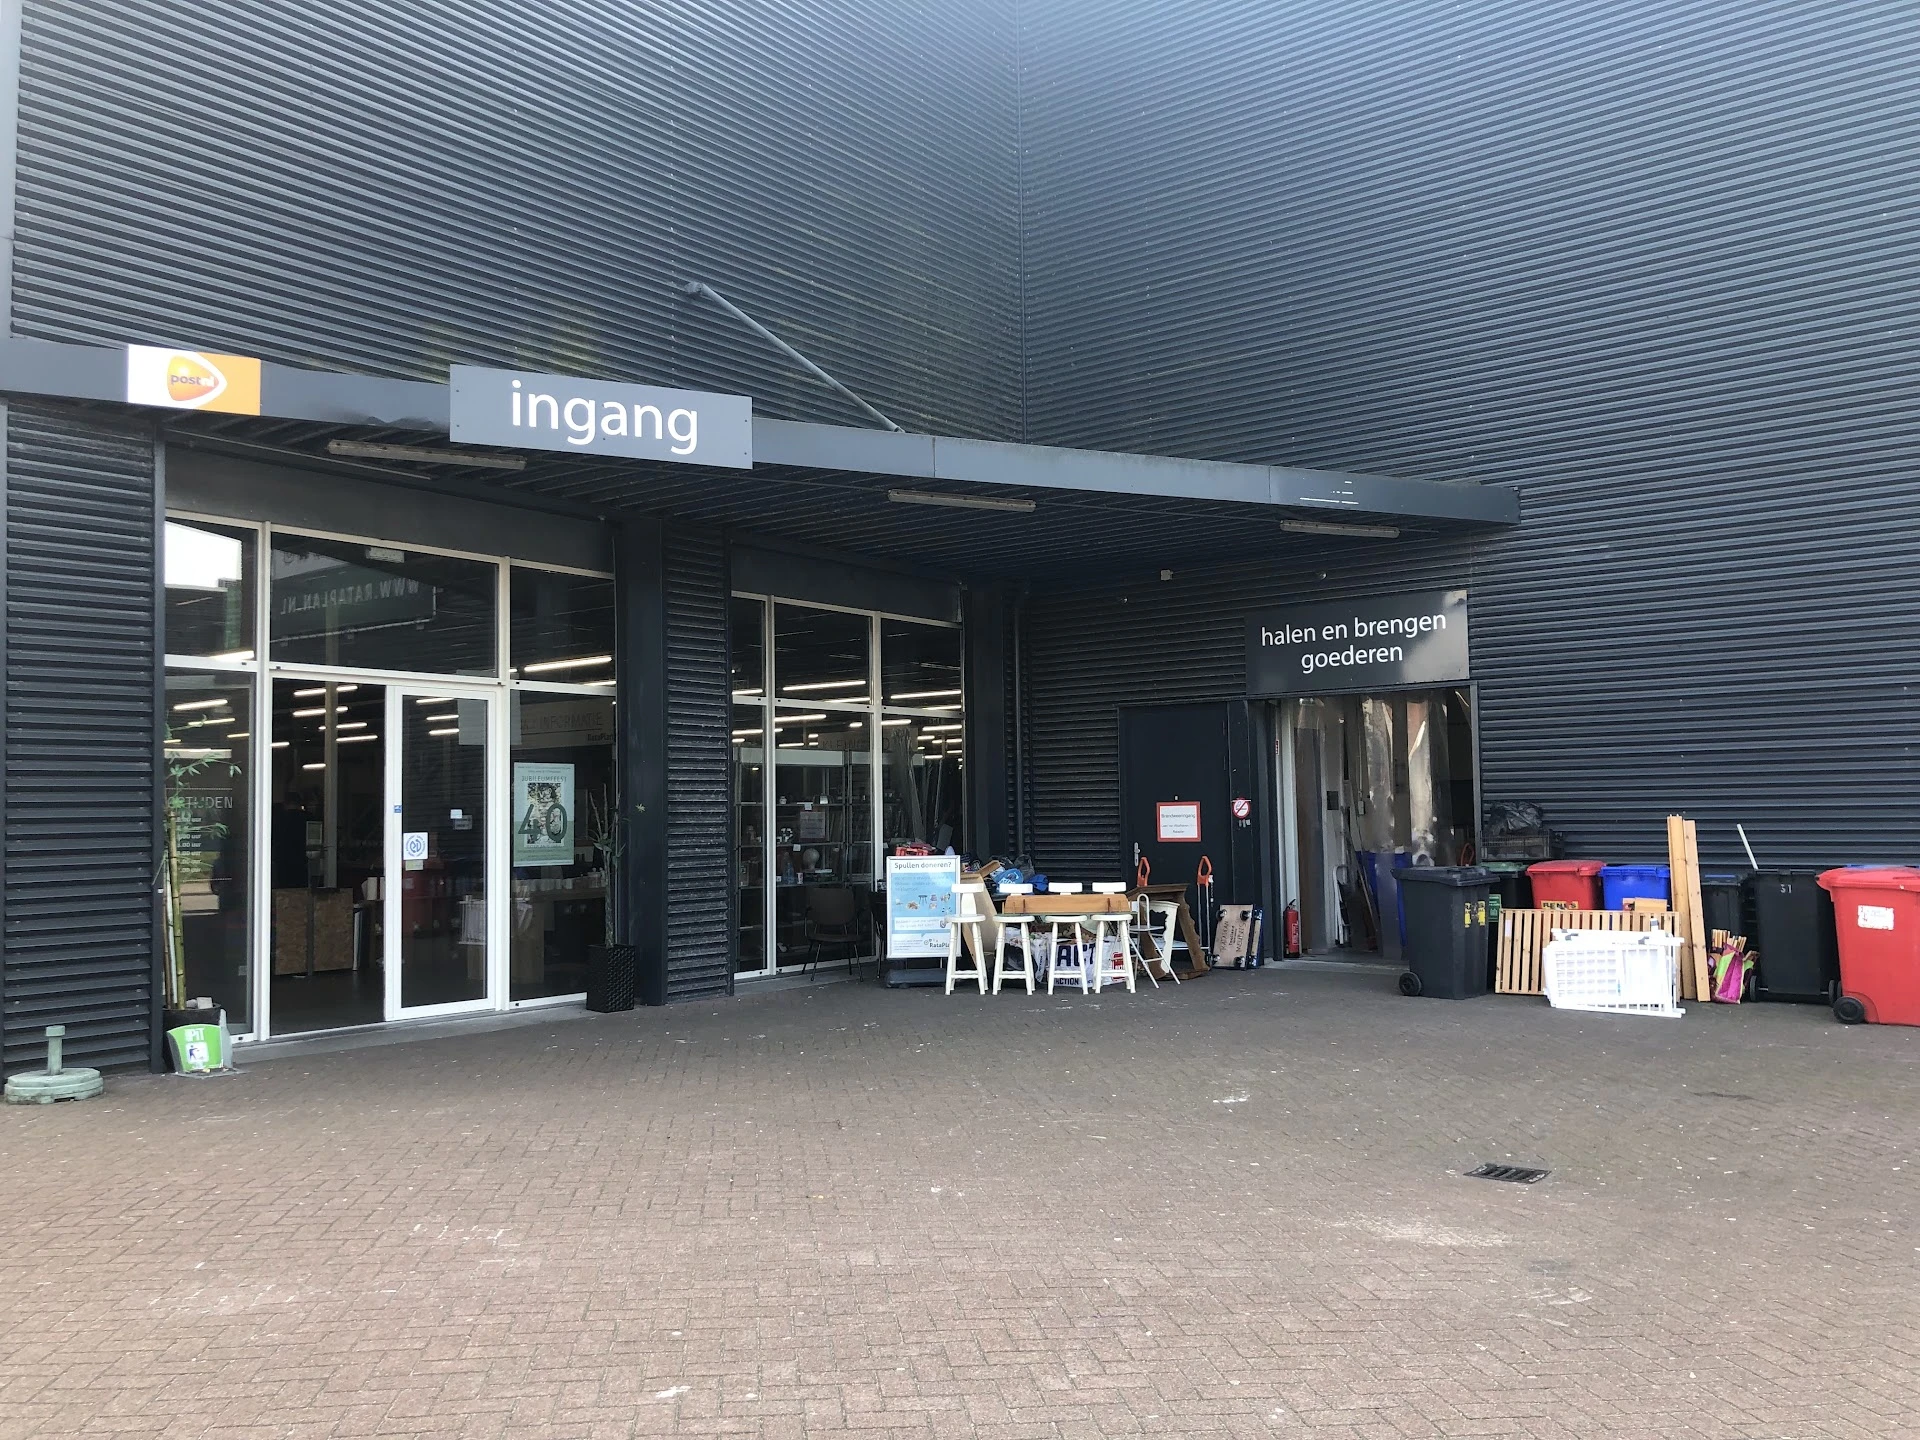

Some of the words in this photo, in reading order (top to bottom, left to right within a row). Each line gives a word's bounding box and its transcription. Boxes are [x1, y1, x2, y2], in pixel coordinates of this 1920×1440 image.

[511, 379, 698, 455] ingang
[1261, 624, 1316, 646] halen
[1322, 623, 1348, 640] en
[1354, 614, 1447, 638] brengen
[1301, 645, 1403, 674] goederen
[521, 775, 568, 783] JUBILEUMFEEST
[517, 803, 568, 843] 40
[894, 862, 920, 870] Spullen
[920, 861, 952, 869] doneren?
